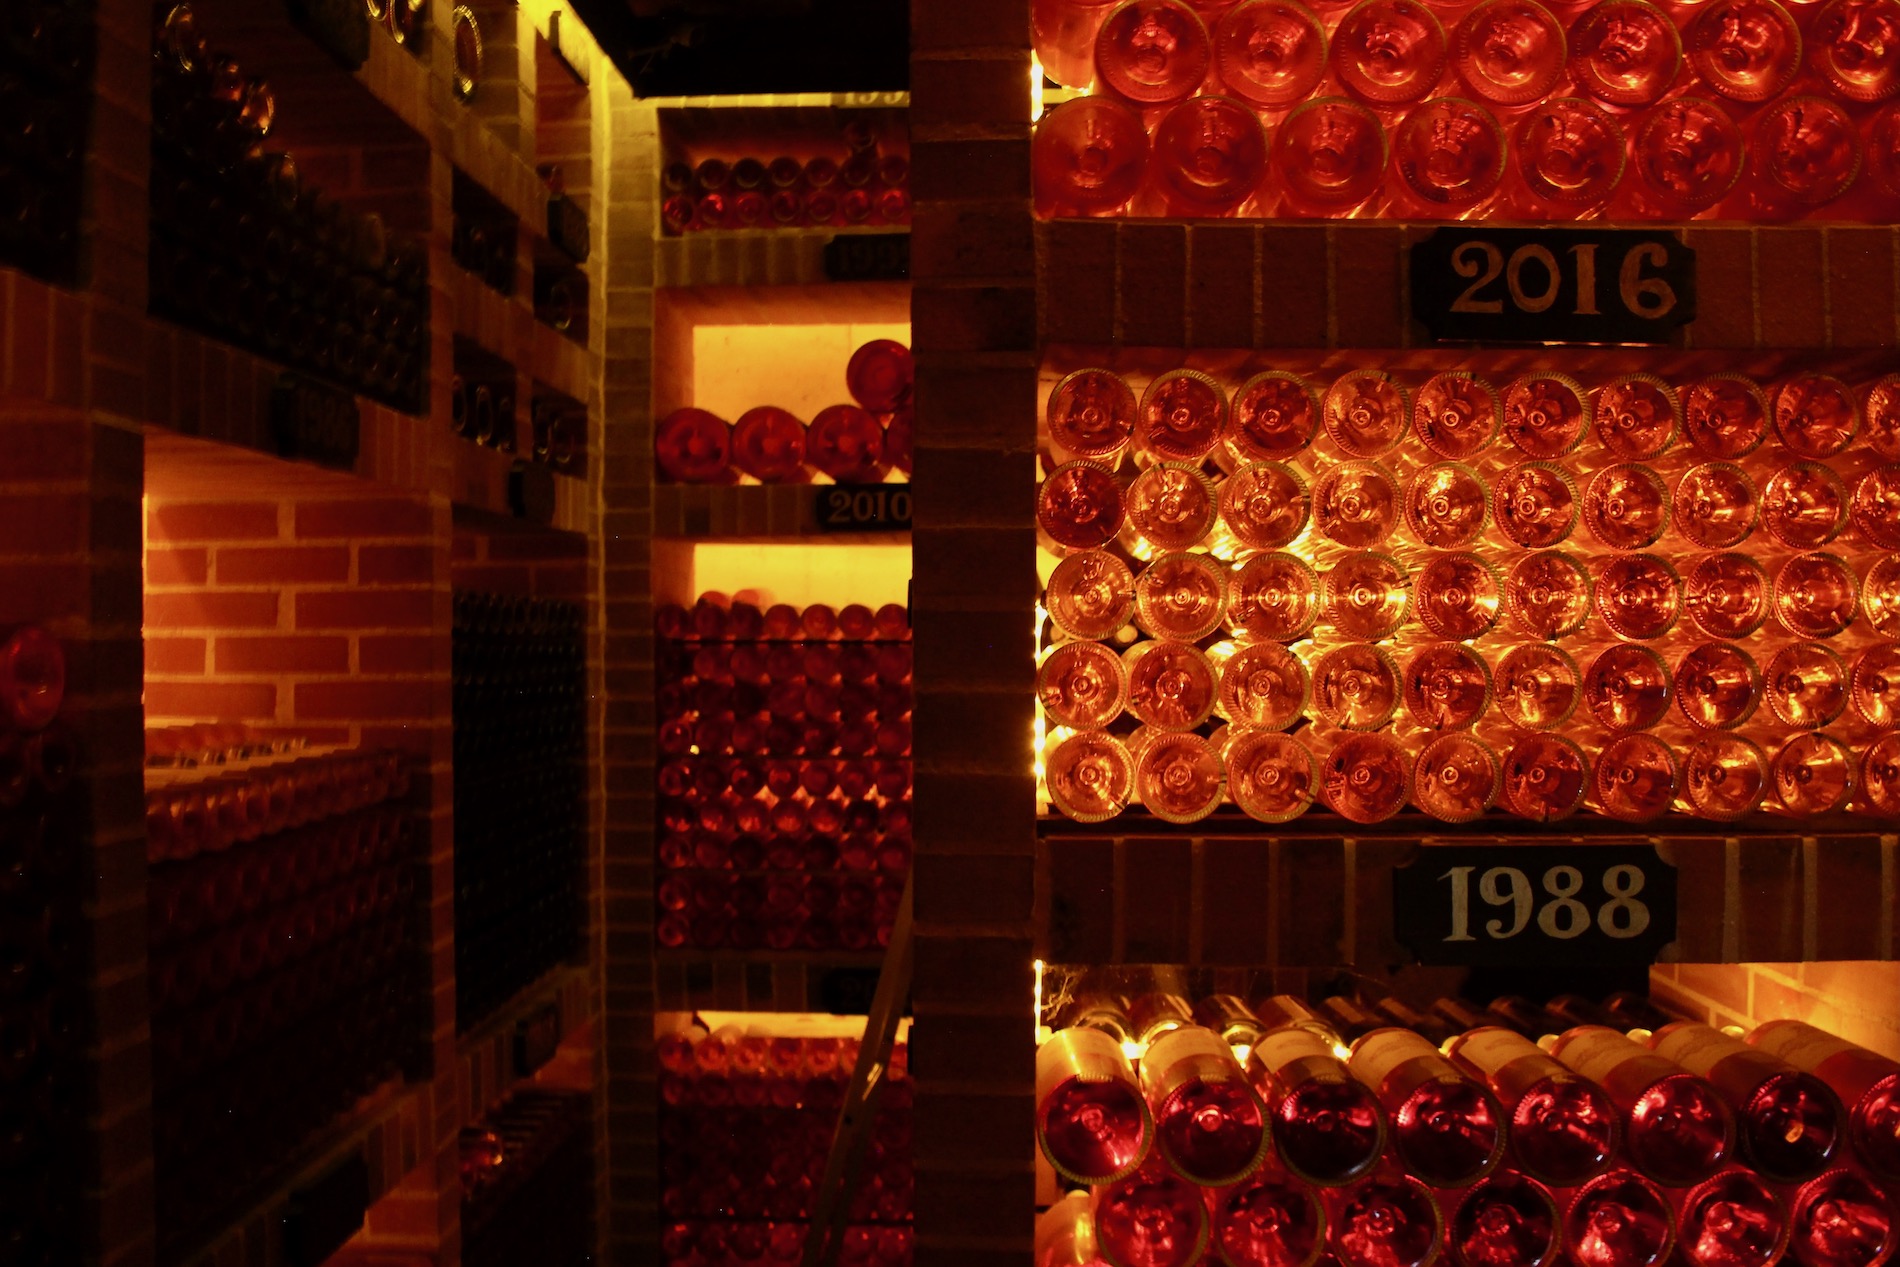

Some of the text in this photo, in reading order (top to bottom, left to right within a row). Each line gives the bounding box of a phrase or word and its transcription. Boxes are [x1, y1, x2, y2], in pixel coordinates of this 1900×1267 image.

[1450, 240, 1677, 320] 2016
[827, 490, 912, 522] 2010
[1437, 864, 1650, 941] 1988
